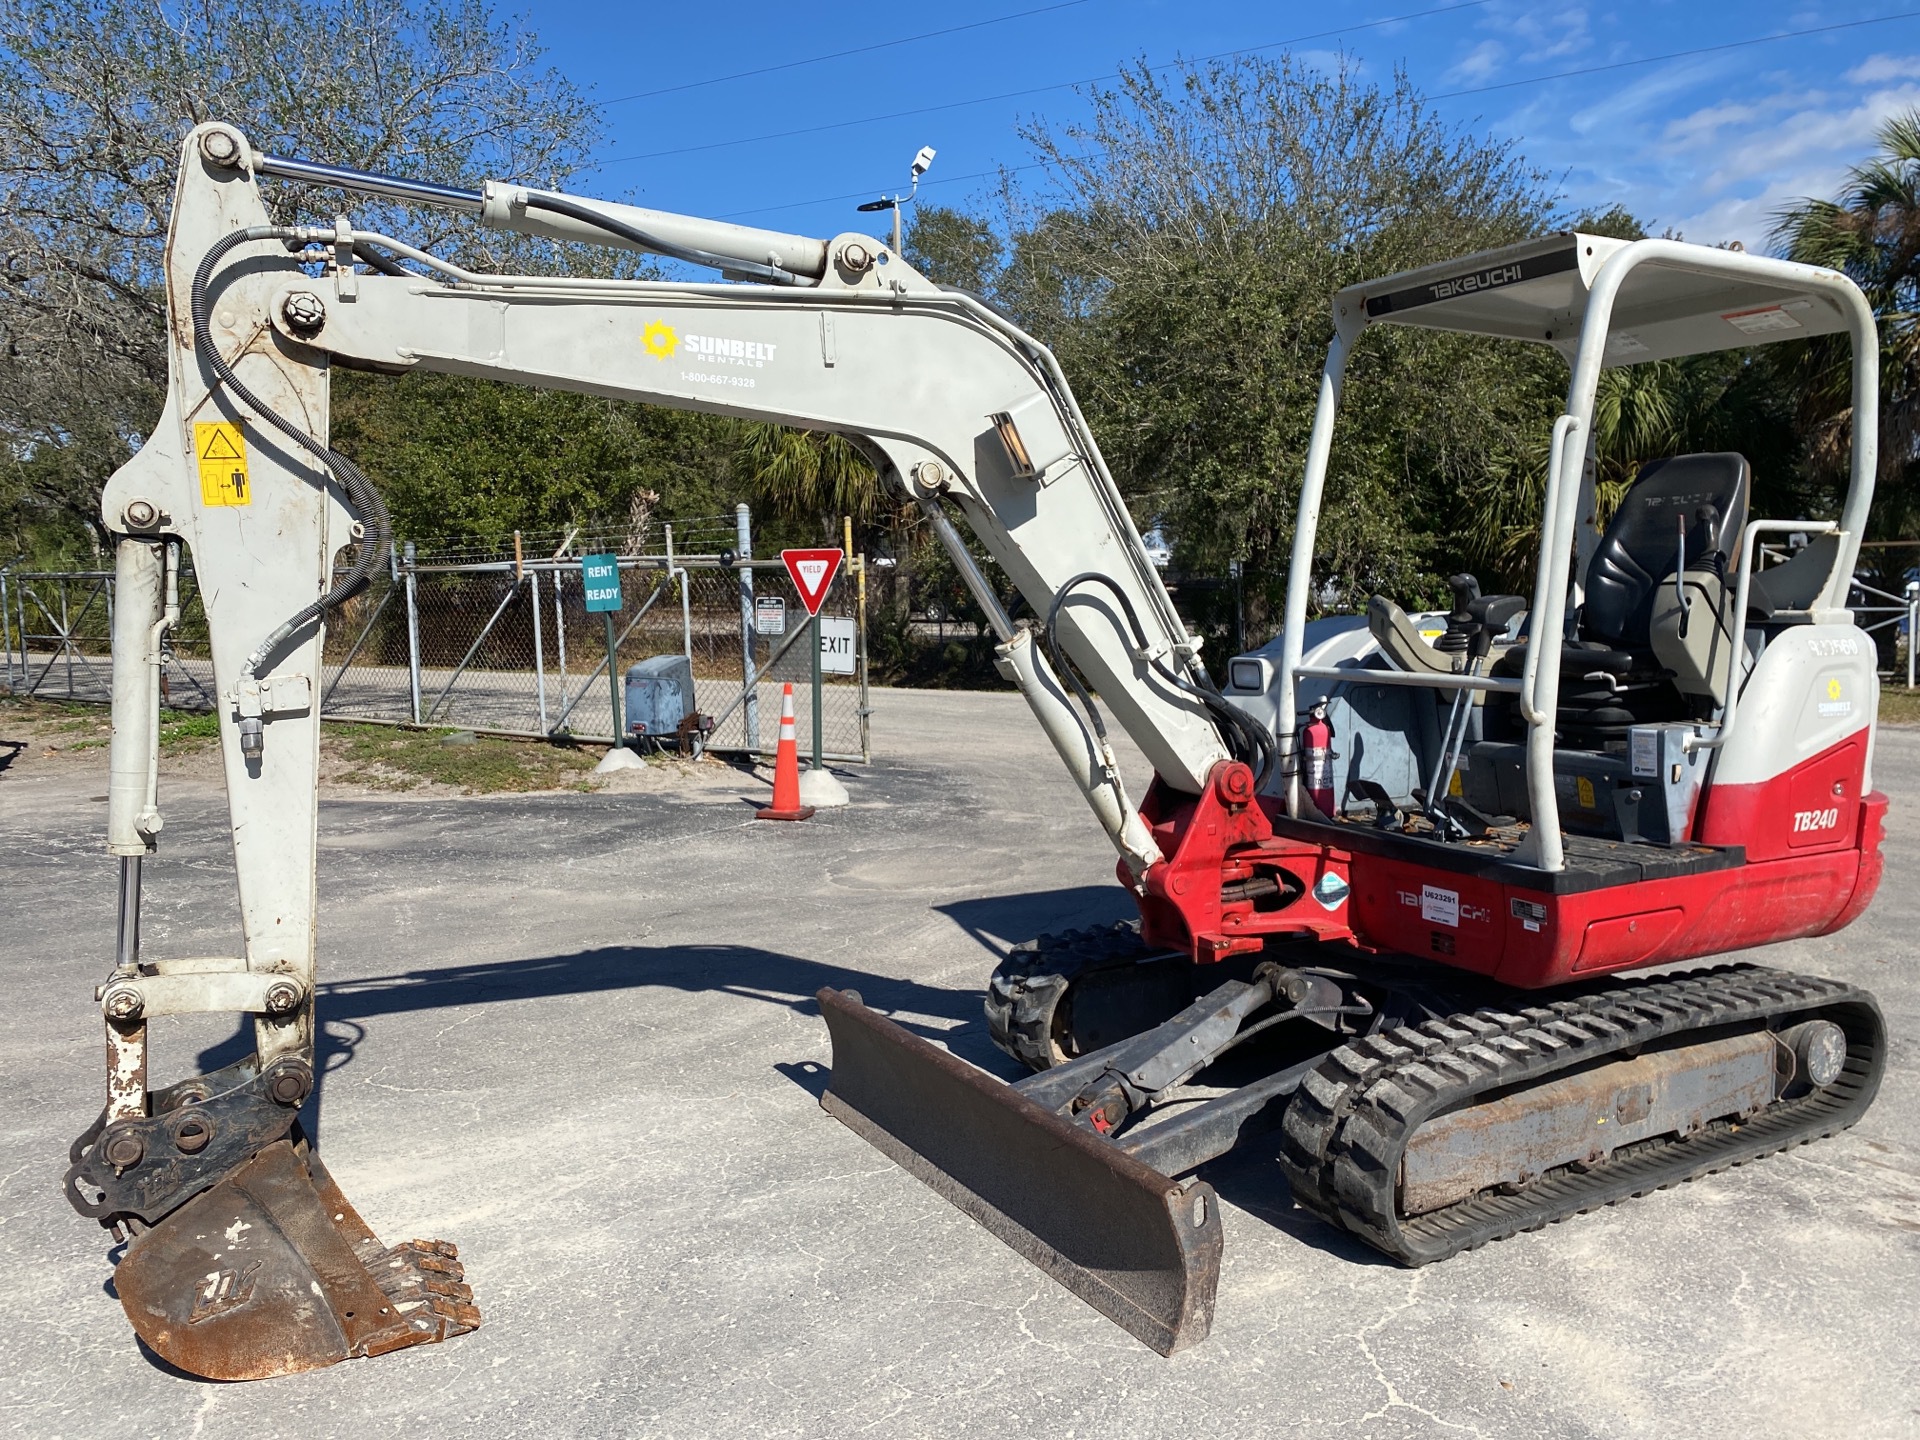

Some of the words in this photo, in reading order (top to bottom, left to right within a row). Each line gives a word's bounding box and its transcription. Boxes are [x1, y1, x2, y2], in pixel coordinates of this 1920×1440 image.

[684, 334, 777, 361] SUNBELT
[697, 354, 764, 368] RENTALS
[680, 371, 756, 388] 1-800-667-9328
[587, 565, 613, 579] RENT
[802, 564, 822, 574] YIELD
[586, 588, 619, 601] READY
[821, 636, 851, 655] EXIT
[1793, 807, 1838, 833] TB240
[1424, 890, 1456, 904] U623291
